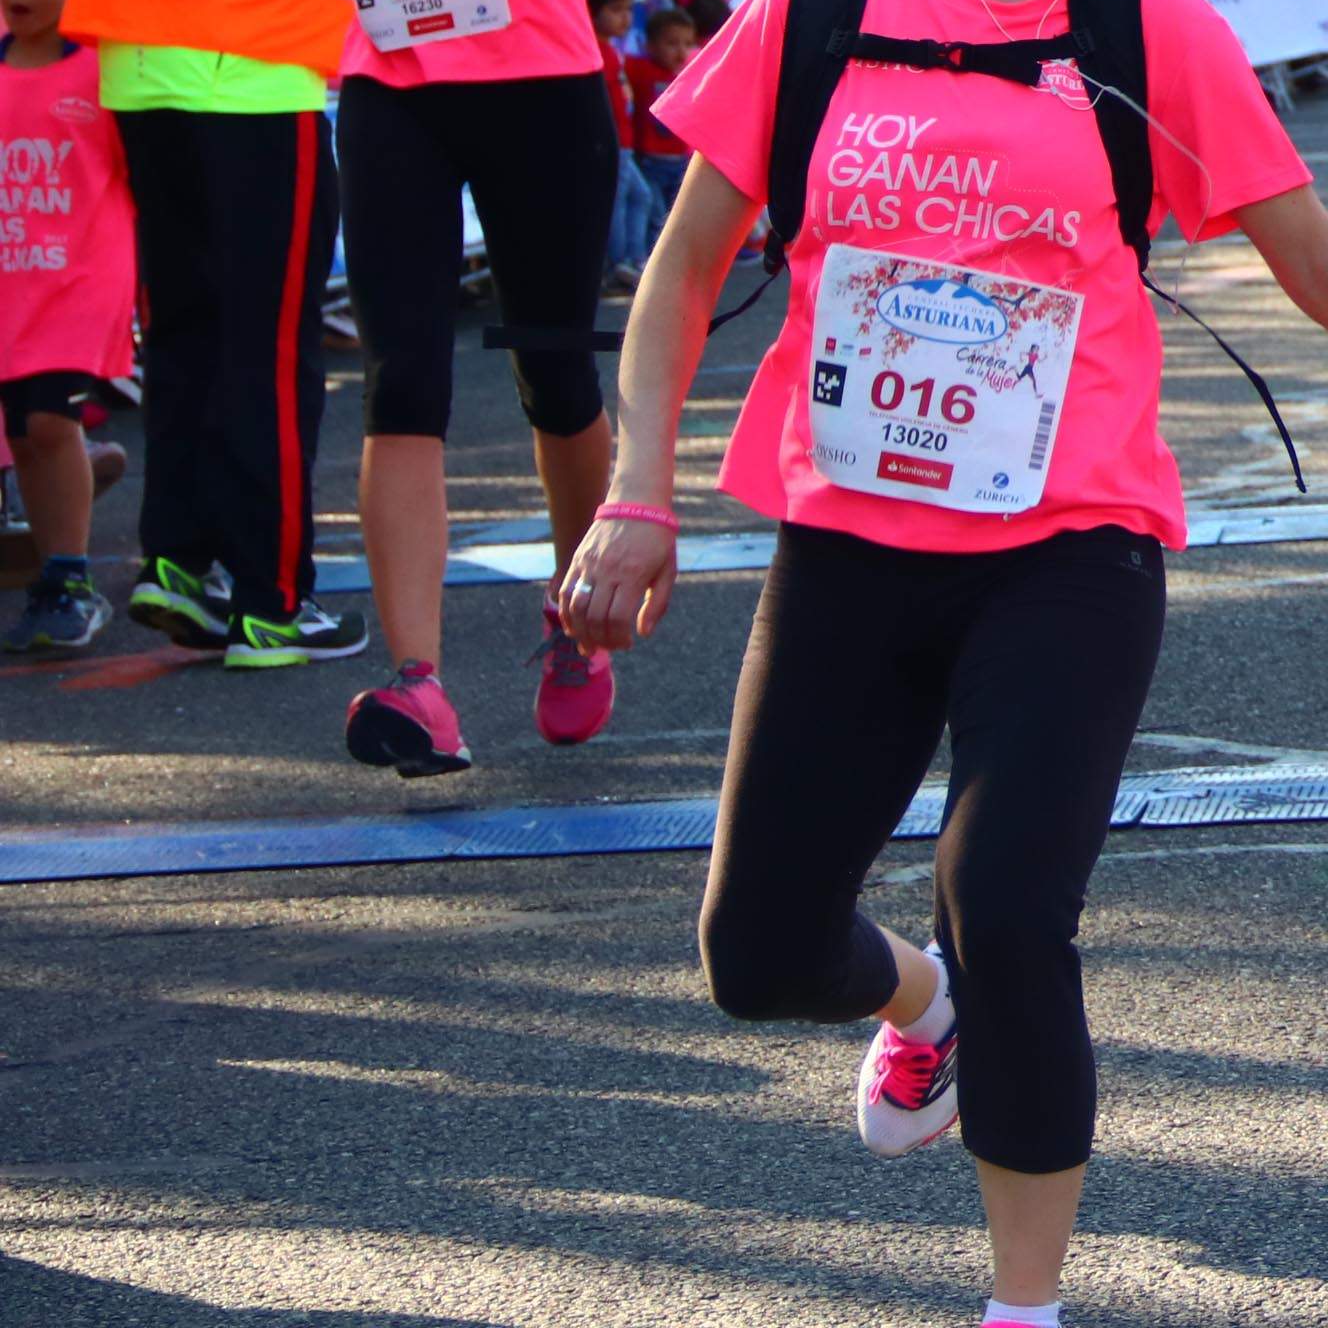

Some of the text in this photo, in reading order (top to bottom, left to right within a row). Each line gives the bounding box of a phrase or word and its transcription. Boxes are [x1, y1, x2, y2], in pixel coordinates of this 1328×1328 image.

[836, 112, 939, 150] HOY
[827, 148, 999, 198] GANAN
[826, 190, 1081, 249] LAS CHICAS
[886, 293, 997, 336] ASTURIANA
[870, 370, 978, 425] 016
[882, 423, 948, 452] 13020
